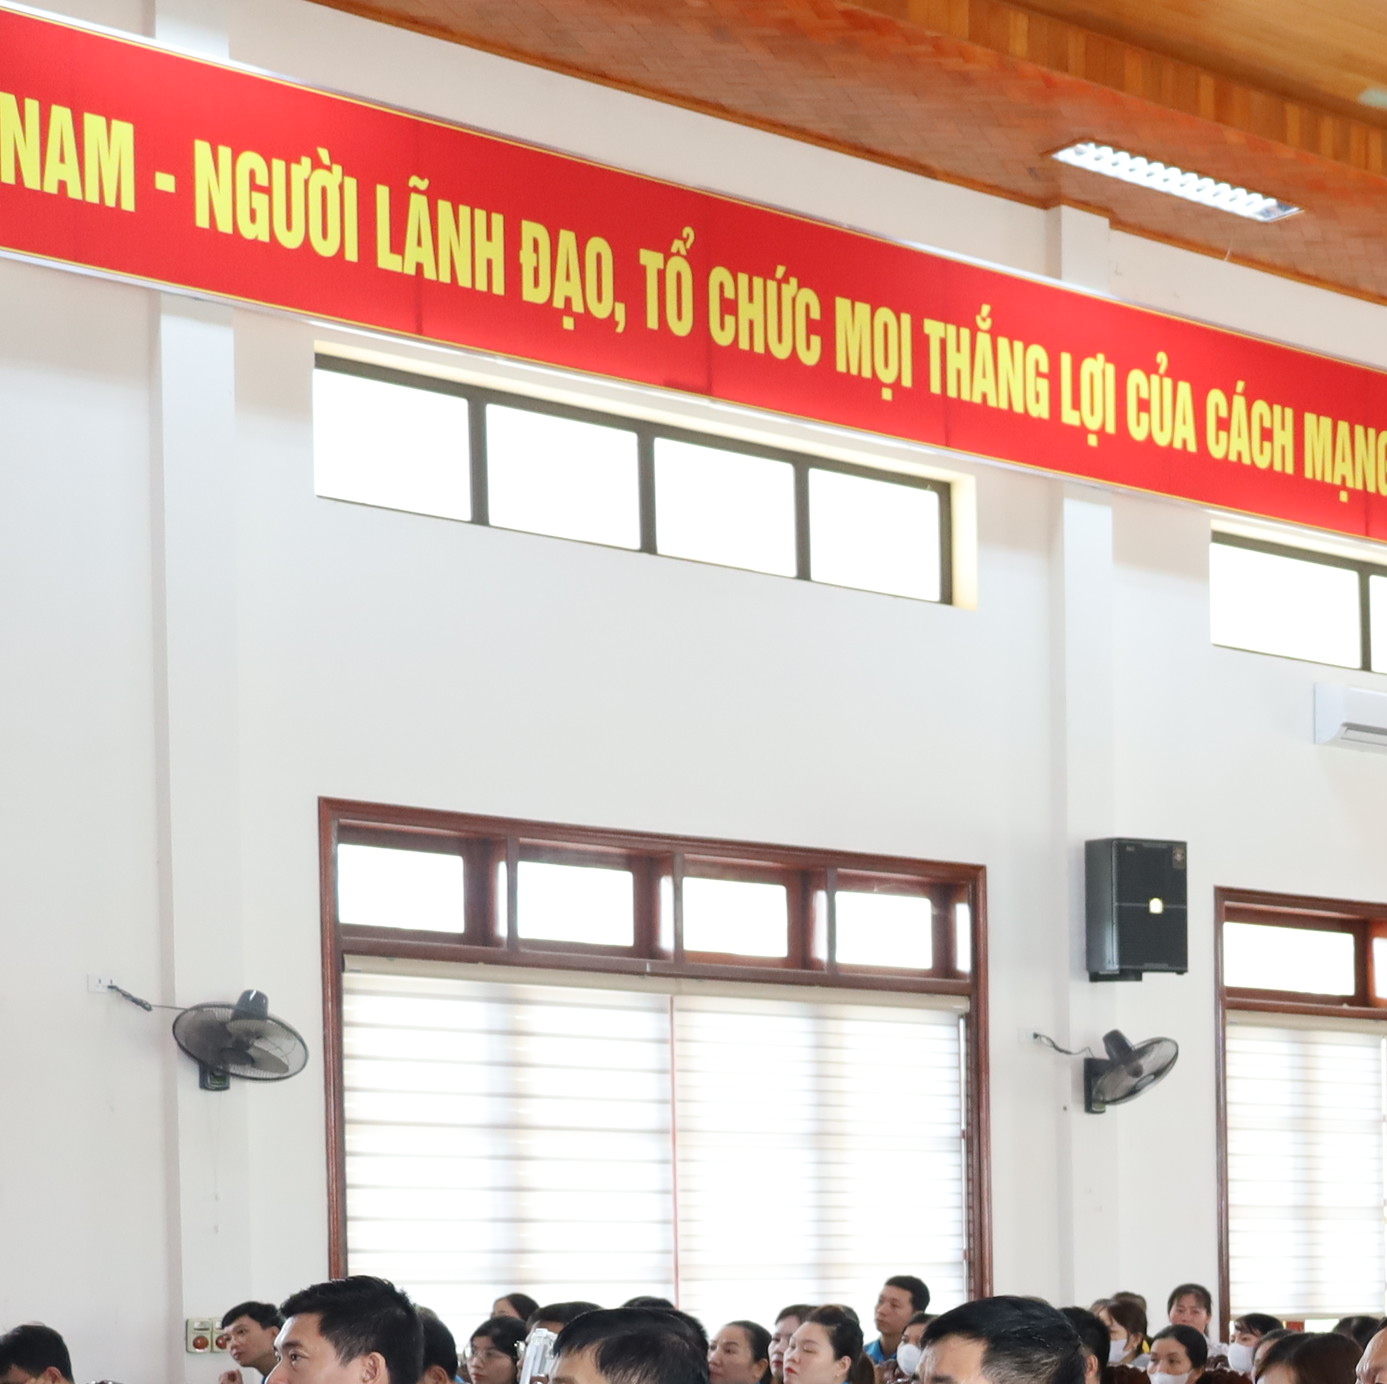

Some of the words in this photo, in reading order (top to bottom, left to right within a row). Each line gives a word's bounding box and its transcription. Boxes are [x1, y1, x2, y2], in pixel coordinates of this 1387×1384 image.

[0, 90, 136, 212] NAM
[154, 171, 176, 193] -
[194, 138, 359, 263] NGƯỜI
[376, 175, 505, 296] LÃNH
[519, 219, 626, 333] ĐẠO,
[640, 226, 695, 337] TỔ
[708, 265, 822, 366] CHỨC
[835, 297, 913, 401] MỌI
[924, 303, 1051, 420] THẮNG
[1059, 351, 1117, 447] LỢI
[1126, 351, 1198, 453] CỦA
[1206, 380, 1295, 475] CÁCH
